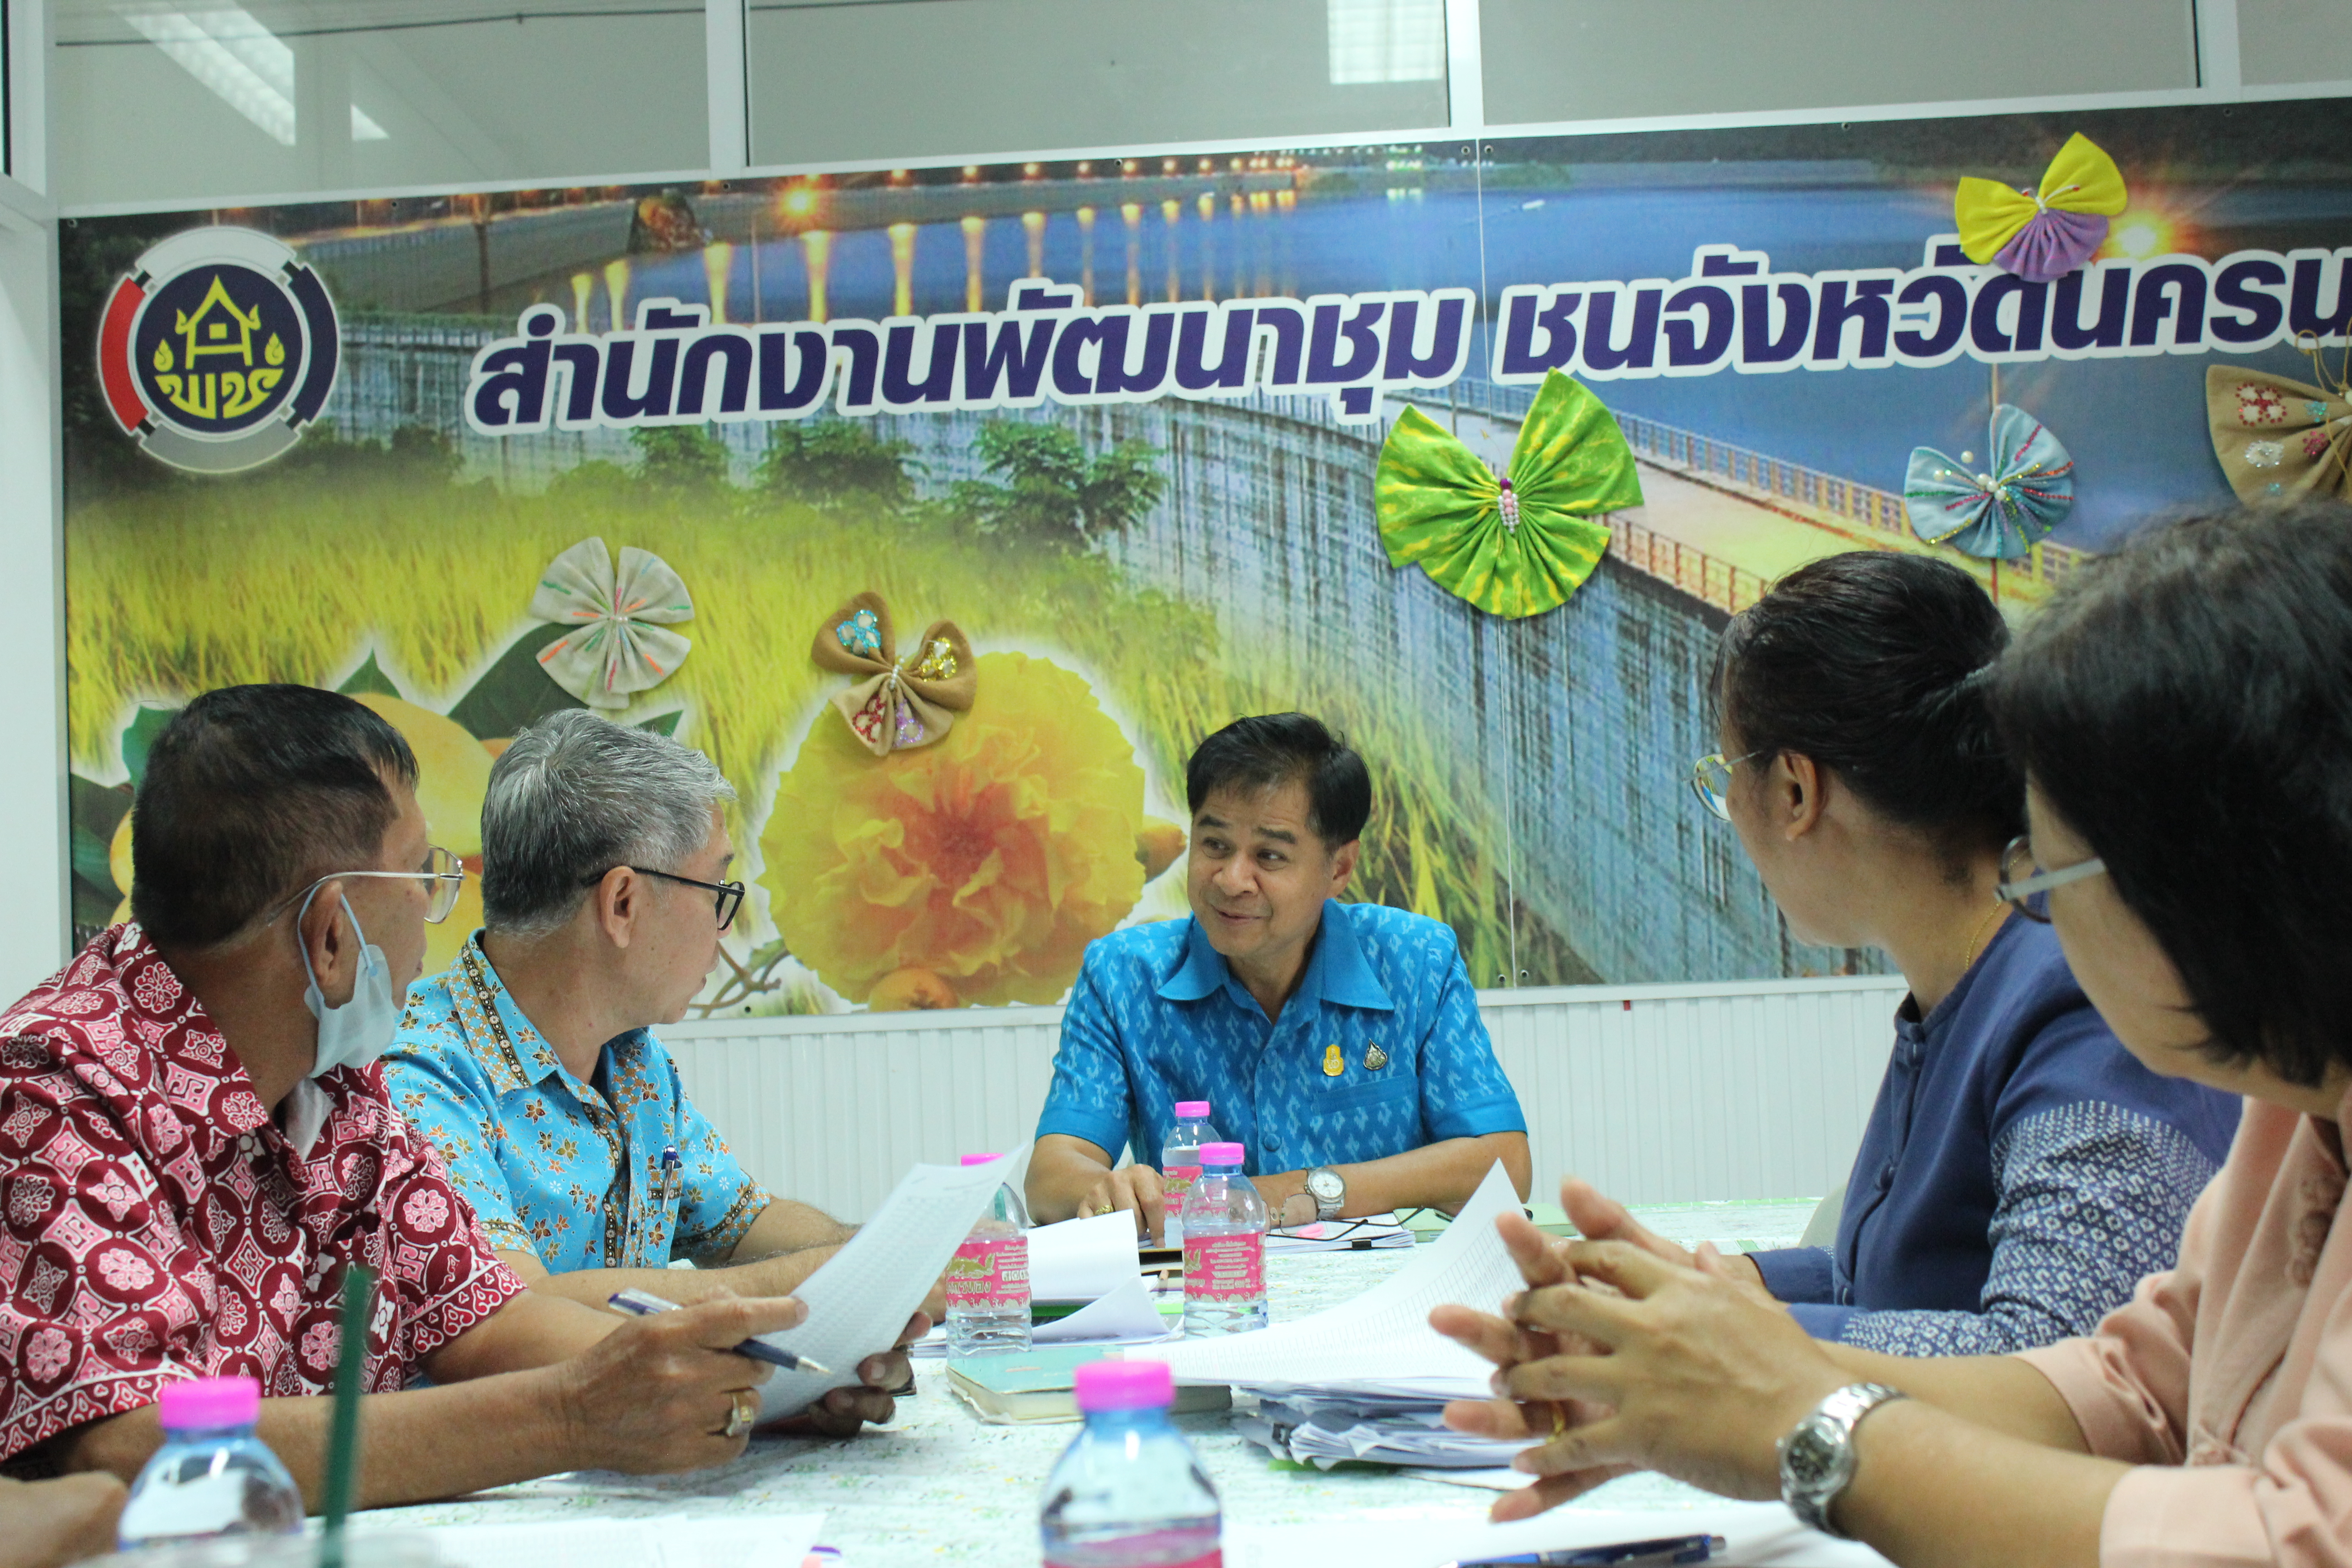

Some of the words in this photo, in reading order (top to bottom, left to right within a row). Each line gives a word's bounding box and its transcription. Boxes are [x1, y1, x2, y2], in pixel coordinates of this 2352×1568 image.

[474, 288, 1465, 426] สำนักงานพัฒนาชุม
